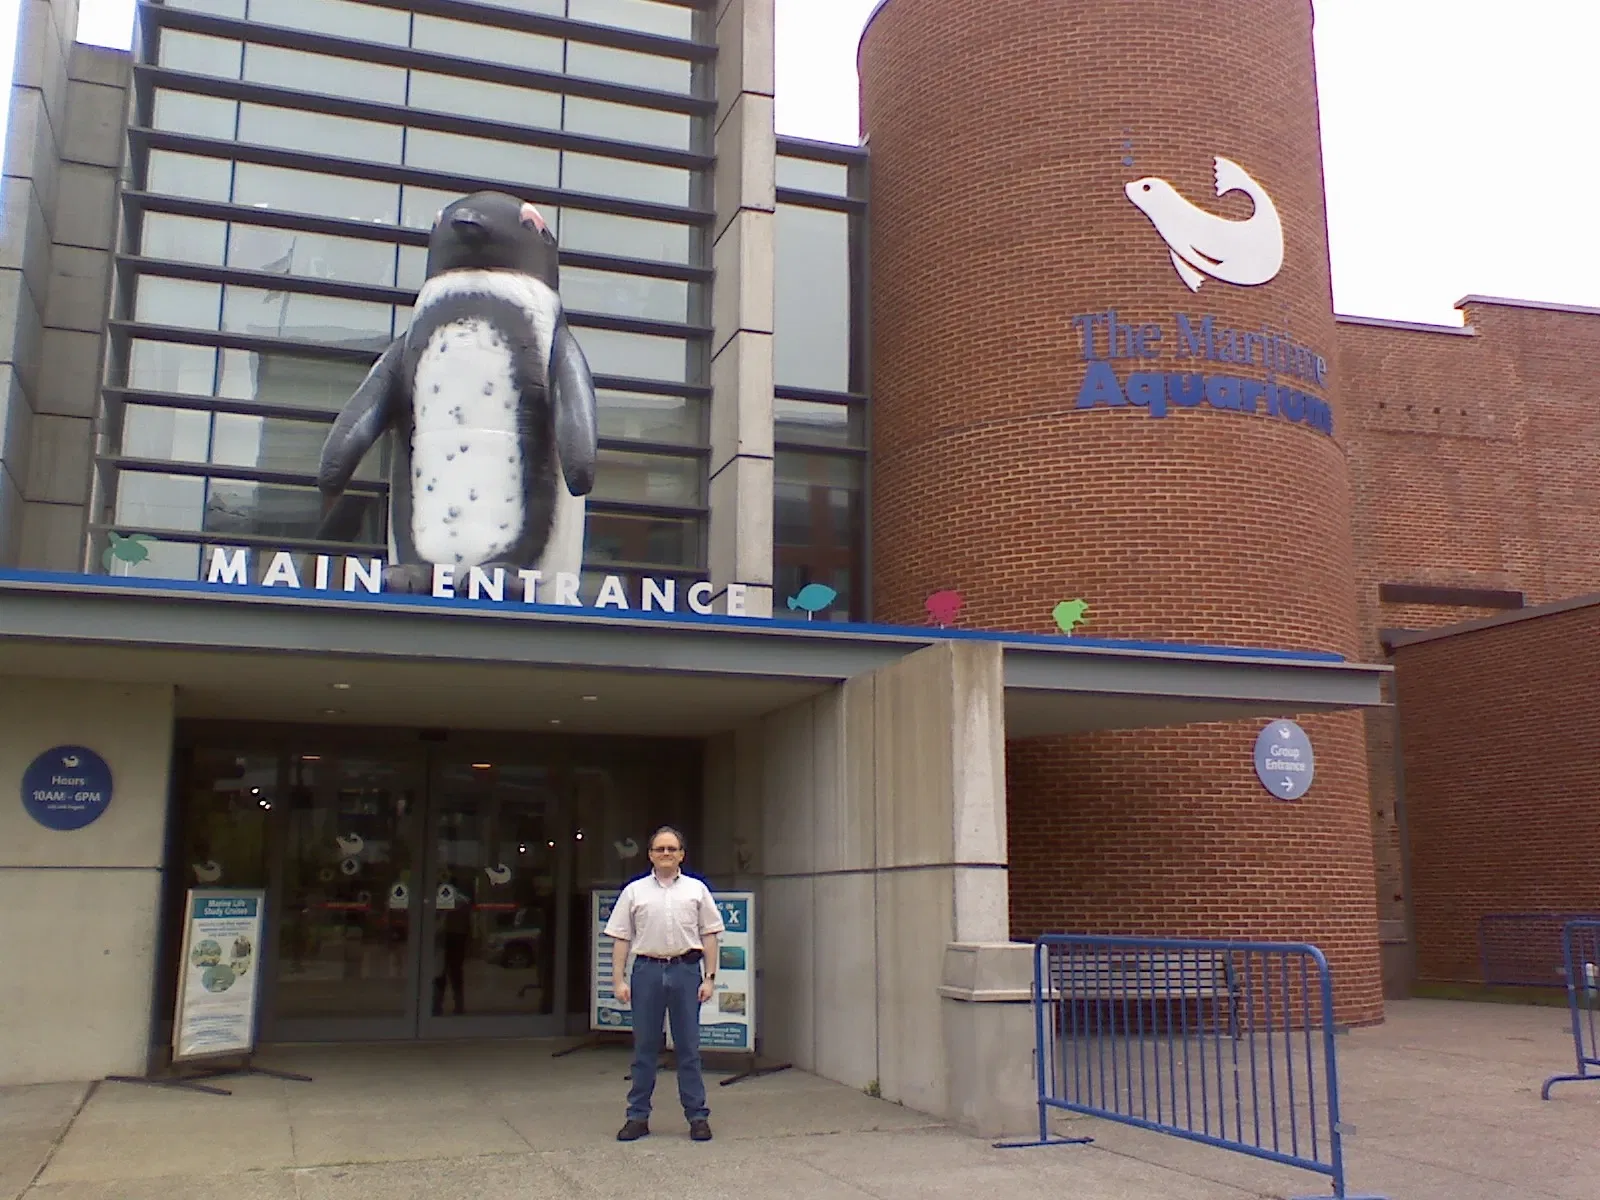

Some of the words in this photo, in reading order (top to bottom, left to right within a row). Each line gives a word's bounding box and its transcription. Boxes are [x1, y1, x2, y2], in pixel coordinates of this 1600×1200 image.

[1072, 310, 1161, 360] The
[1175, 312, 1329, 389] Maritime
[1075, 360, 1333, 437] Aquarium
[207, 547, 382, 594] MAIN
[432, 563, 747, 617] ENTRANCE
[1270, 744, 1300, 760] Group
[1265, 758, 1306, 772] Entrance
[51, 775, 85, 786] Hours
[74, 791, 101, 802] 6PM
[203, 907, 223, 917] Study
